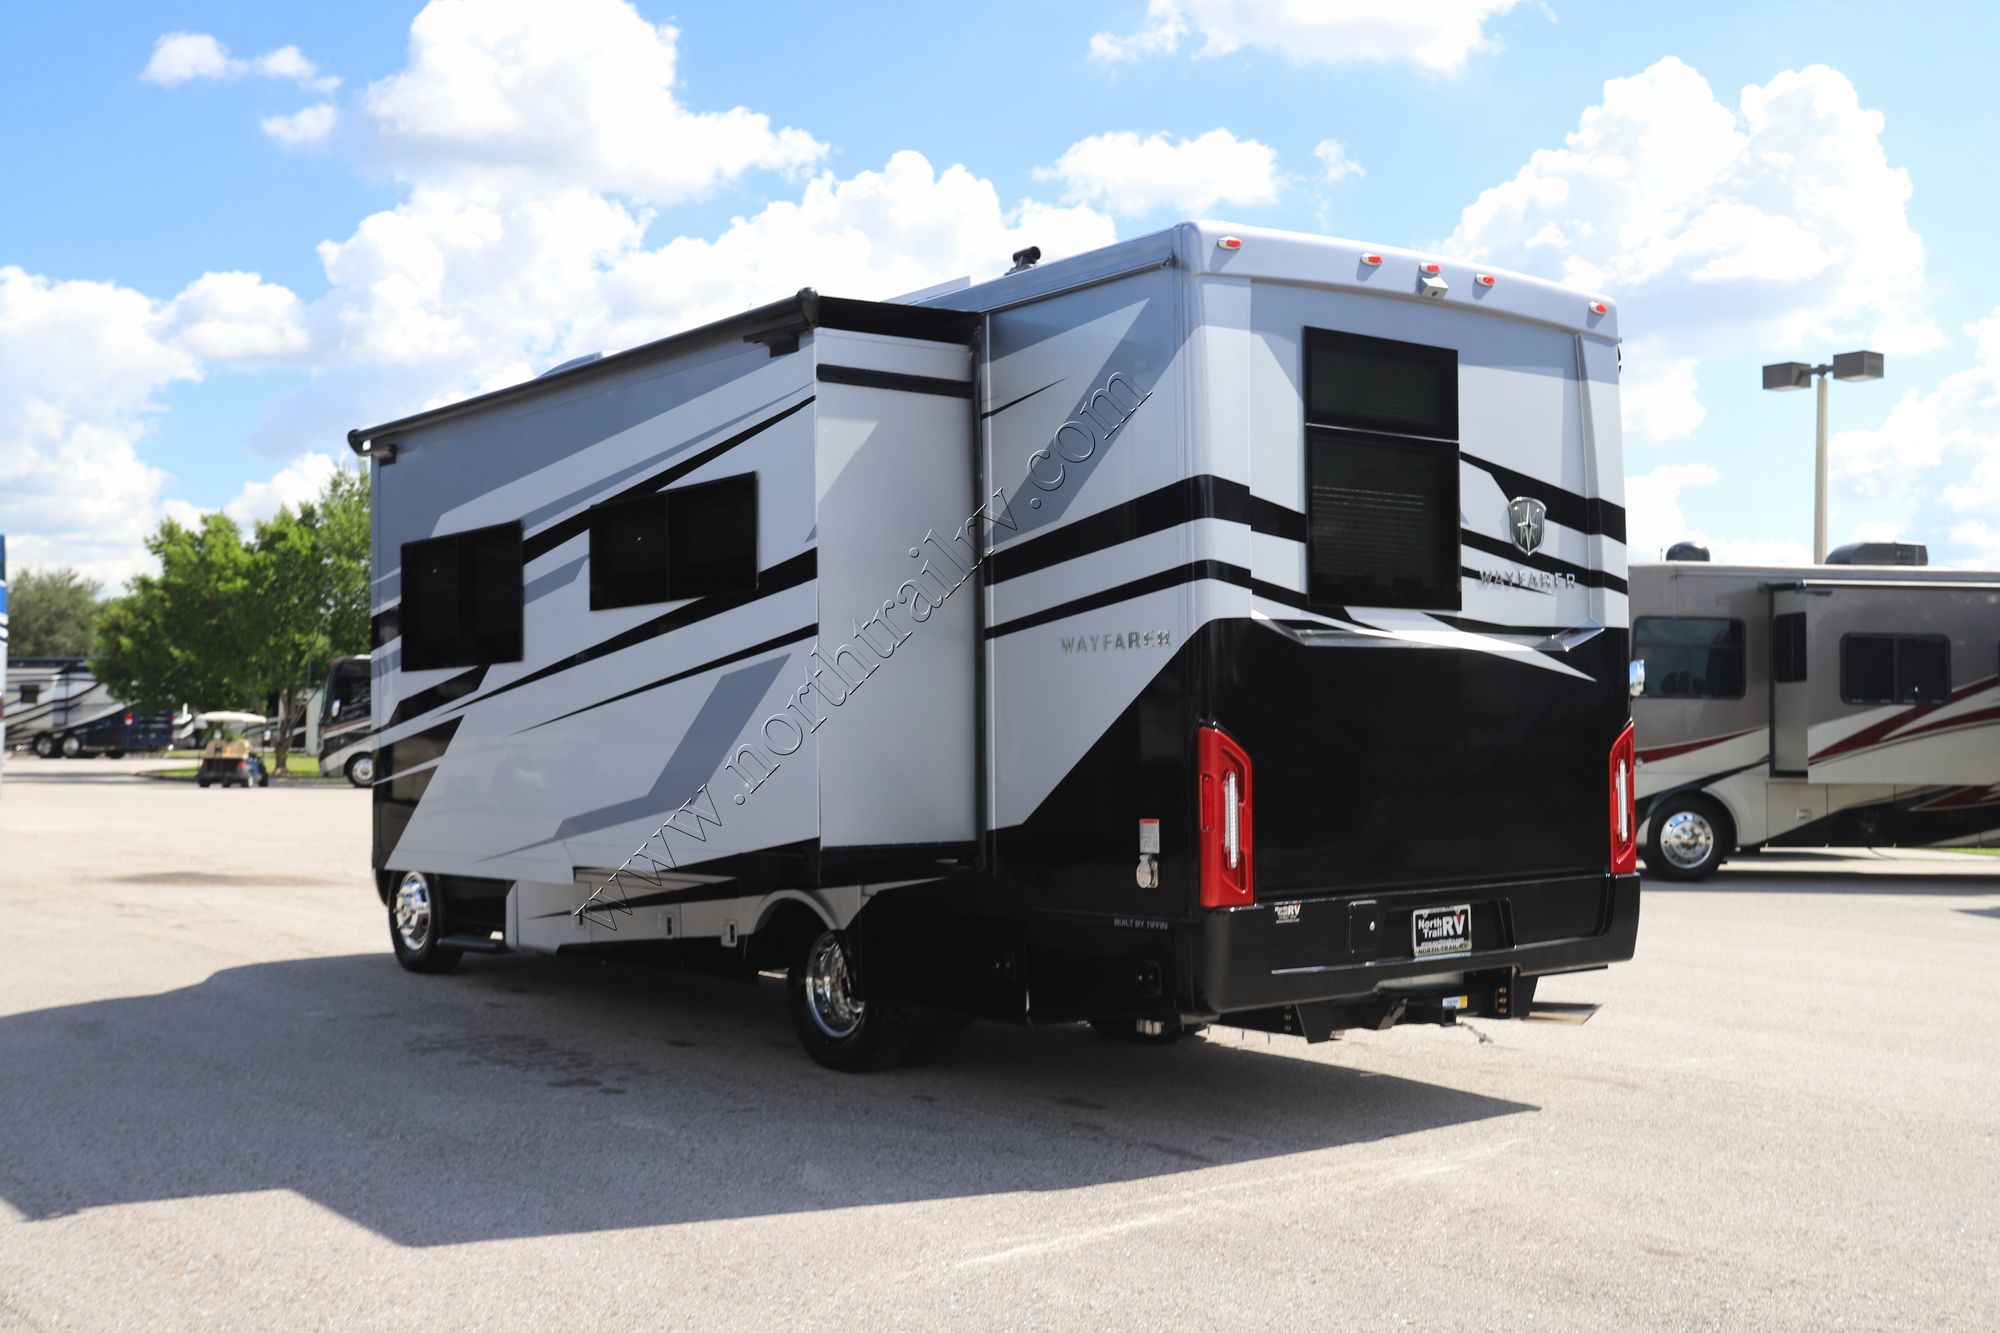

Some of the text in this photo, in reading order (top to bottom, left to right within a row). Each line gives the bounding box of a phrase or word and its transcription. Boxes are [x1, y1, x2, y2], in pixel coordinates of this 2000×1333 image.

[1479, 568, 1576, 590] WAYFARER
[1061, 629, 1170, 654] WAYFARER
[1114, 918, 1168, 931] BUILT BY TIFFIN
[1418, 917, 1442, 930] North
[1442, 914, 1465, 936] RV
[1423, 927, 1442, 939] Trail
